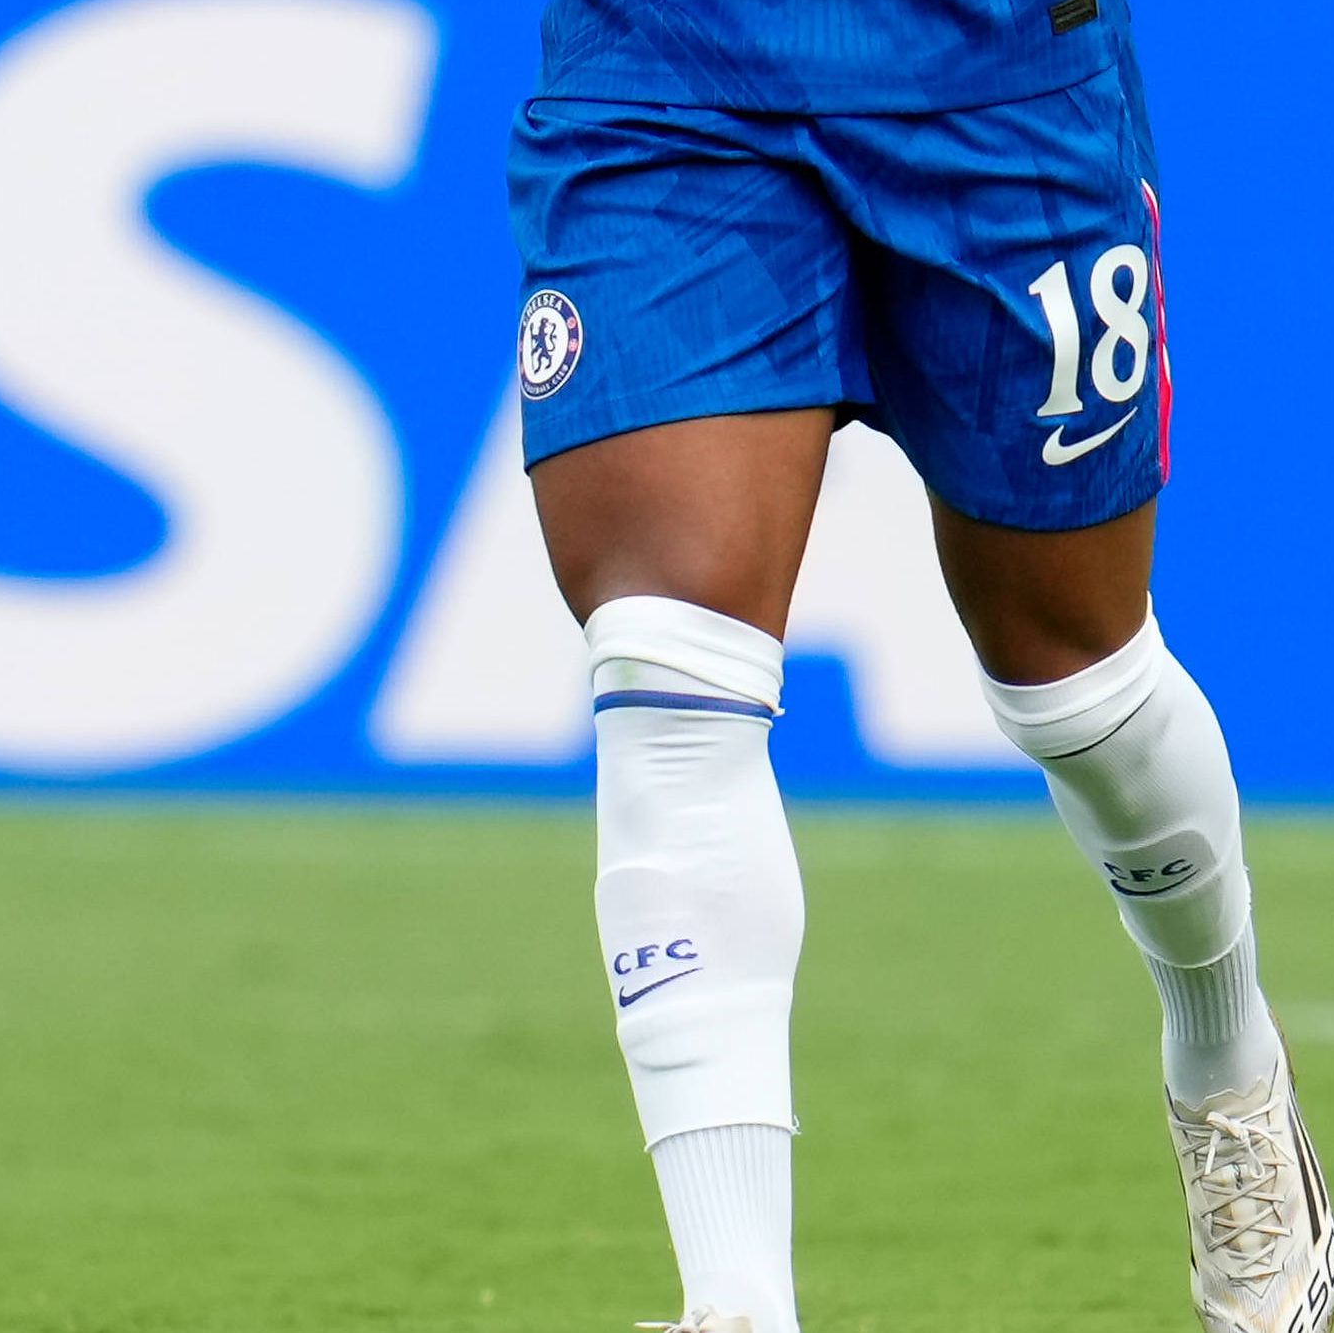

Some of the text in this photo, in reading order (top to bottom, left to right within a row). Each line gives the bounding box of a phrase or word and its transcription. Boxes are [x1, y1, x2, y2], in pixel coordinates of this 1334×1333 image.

[1028, 244, 1148, 417] 18
[1103, 858, 1194, 882] CFC
[613, 938, 698, 975] CFC
